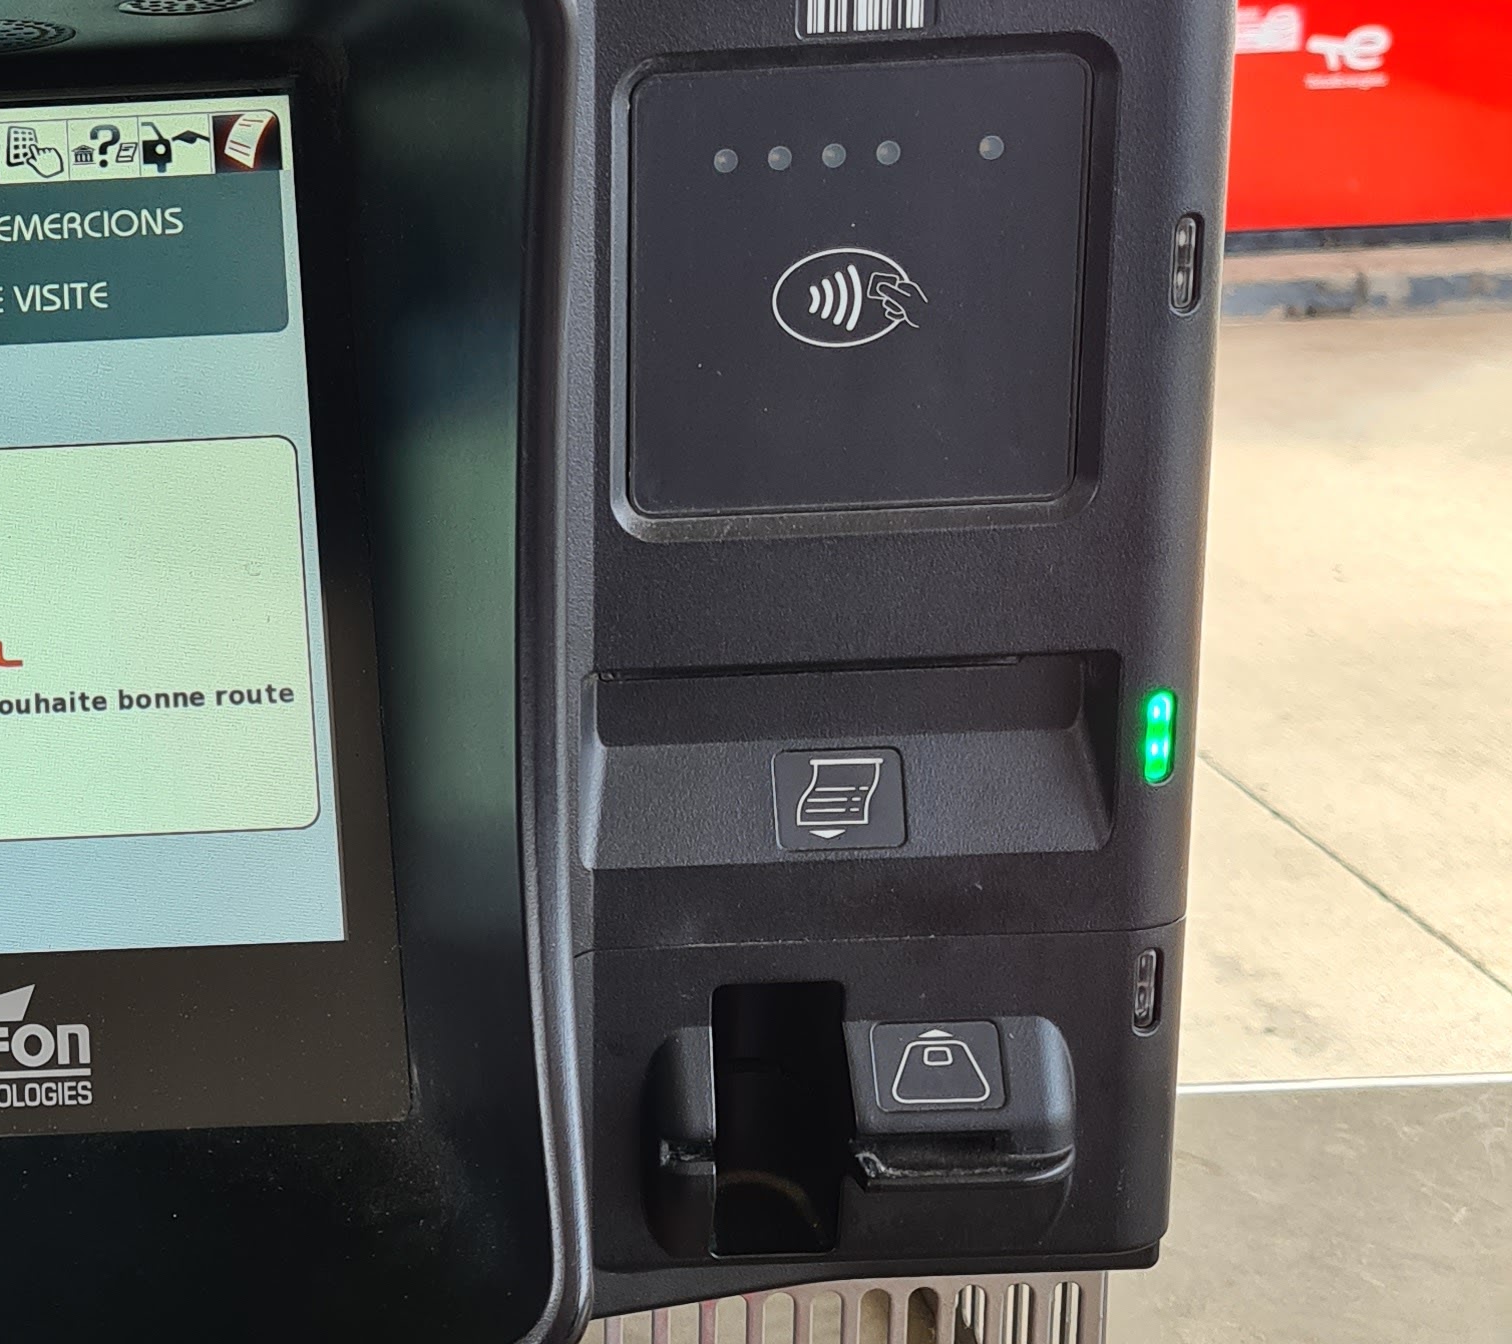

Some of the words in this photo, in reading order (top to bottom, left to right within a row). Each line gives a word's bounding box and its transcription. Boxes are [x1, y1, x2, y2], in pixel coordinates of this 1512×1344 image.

[12, 280, 110, 311] VISITE
[117, 688, 206, 712] bonne
[215, 683, 295, 707] route
